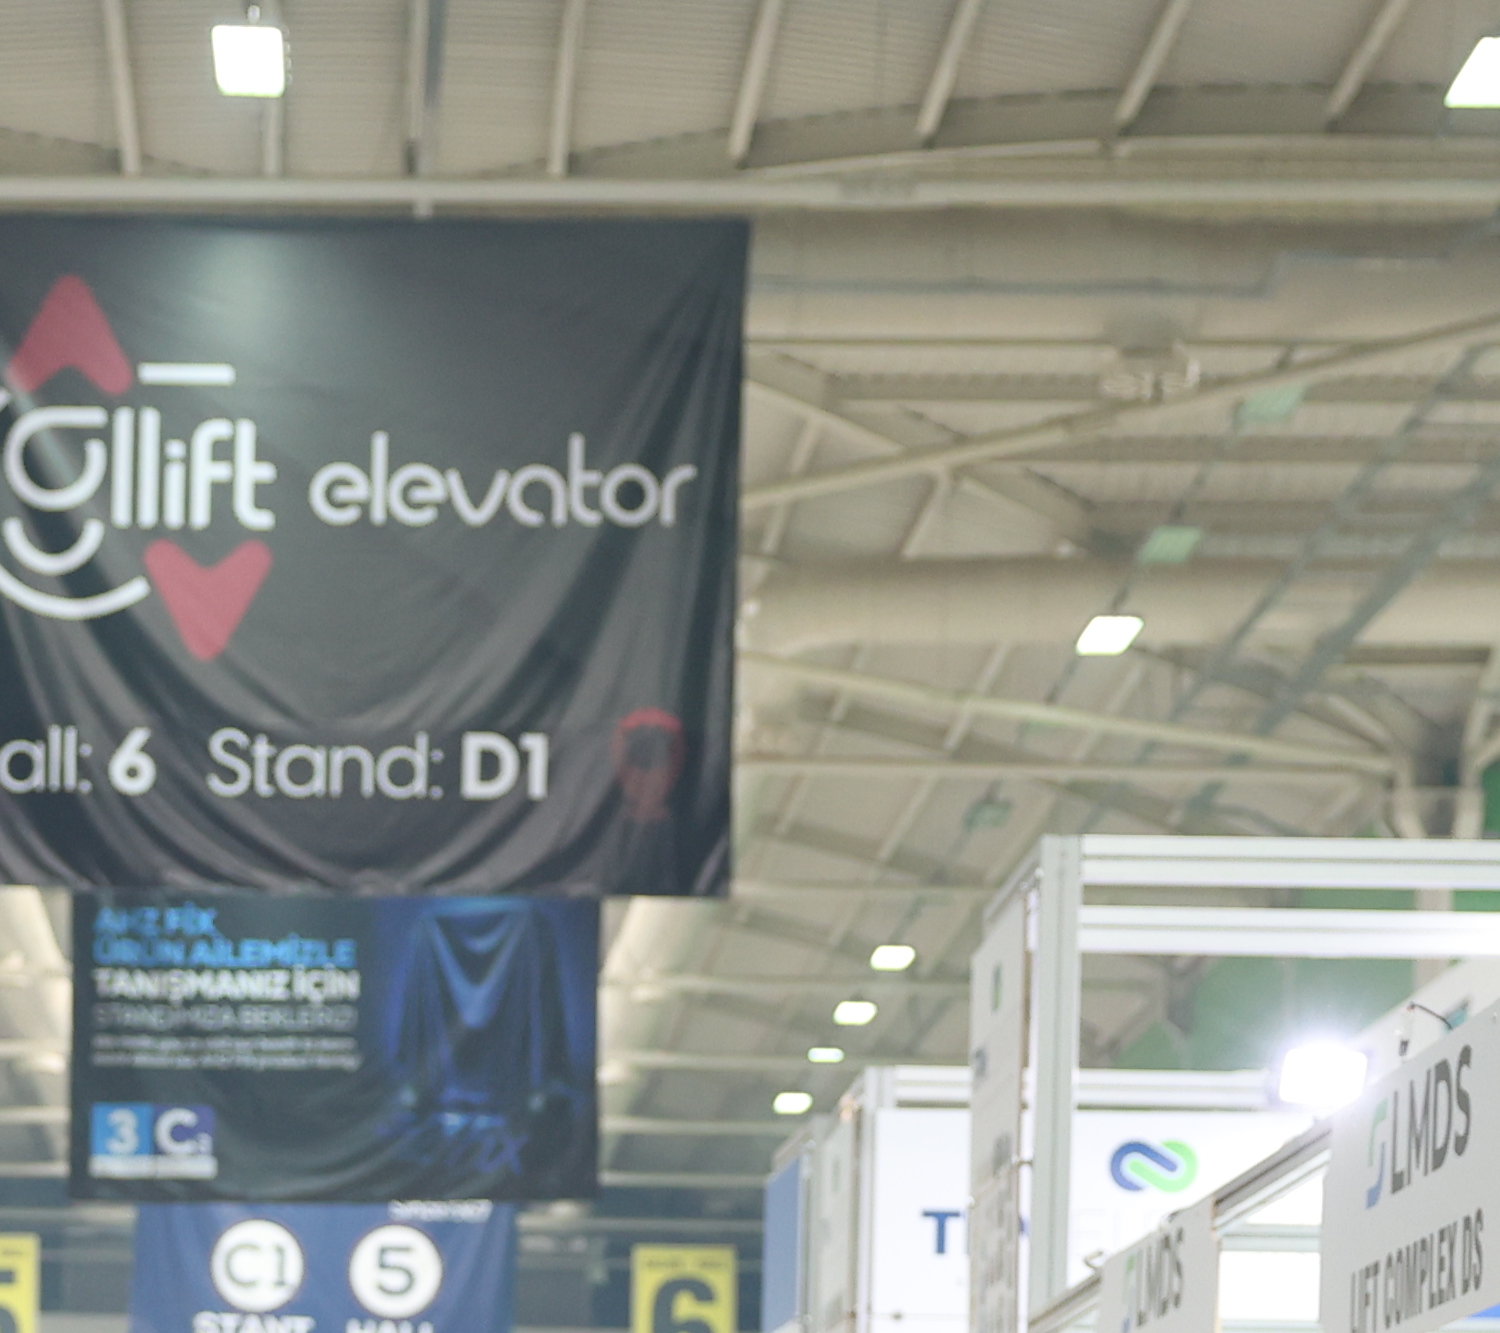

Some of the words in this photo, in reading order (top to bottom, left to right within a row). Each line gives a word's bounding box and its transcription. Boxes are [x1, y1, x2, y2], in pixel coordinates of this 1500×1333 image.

[309, 432, 698, 527] elevator
[108, 729, 156, 796] 6
[206, 729, 444, 800] Stand:
[461, 732, 549, 799] D1
[105, 1108, 138, 1155] 3
[1391, 1044, 1472, 1195] LMDS
[224, 1243, 286, 1287] C1
[375, 1247, 415, 1294] 5
[1384, 1221, 1457, 1330] COMPLEX
[1462, 1207, 1485, 1296] DS
